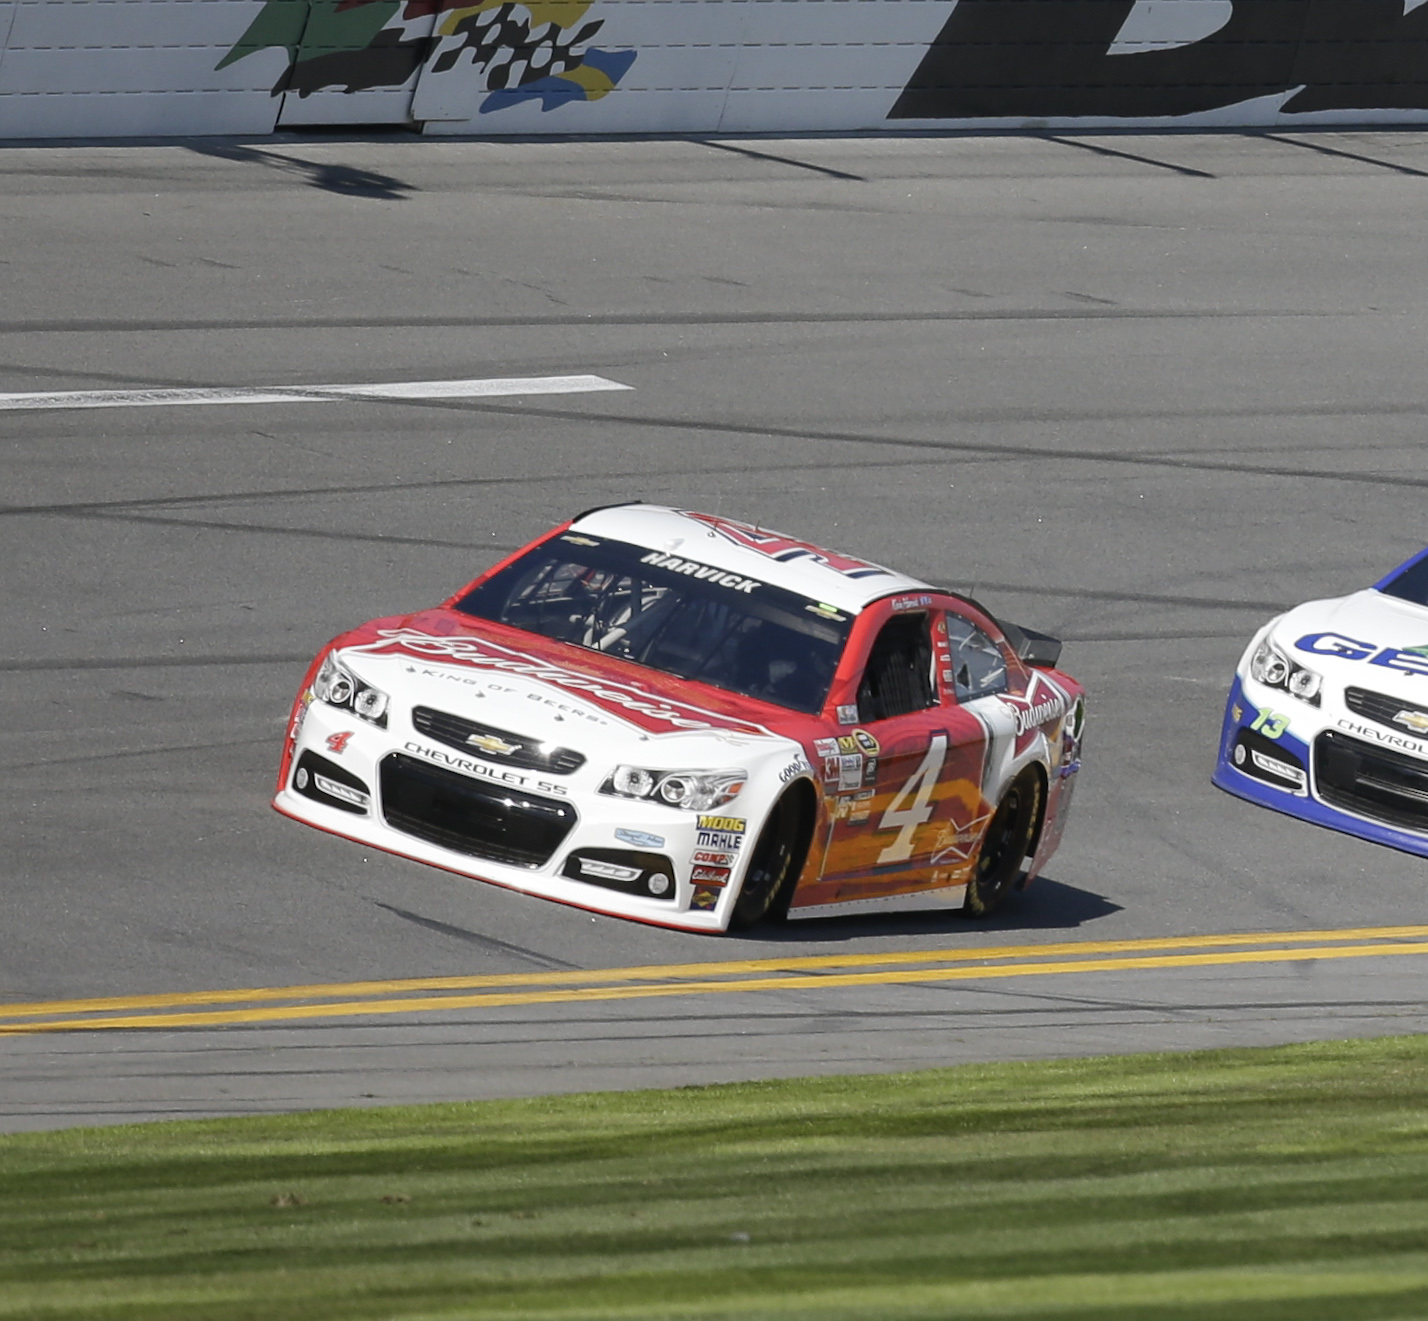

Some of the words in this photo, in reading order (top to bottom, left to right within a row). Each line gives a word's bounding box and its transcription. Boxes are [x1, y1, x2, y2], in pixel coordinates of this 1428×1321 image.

[641, 551, 761, 594] HARVICK
[422, 669, 478, 686] KING
[494, 683, 516, 693] OF
[1250, 706, 1291, 740] 13
[325, 730, 356, 755] 4
[404, 741, 530, 786] CHEVROLET
[537, 781, 568, 796] SS
[876, 729, 948, 865] 4
[698, 816, 745, 831] MOOG
[697, 832, 742, 849] MAHLE
[694, 852, 727, 863] COMP
